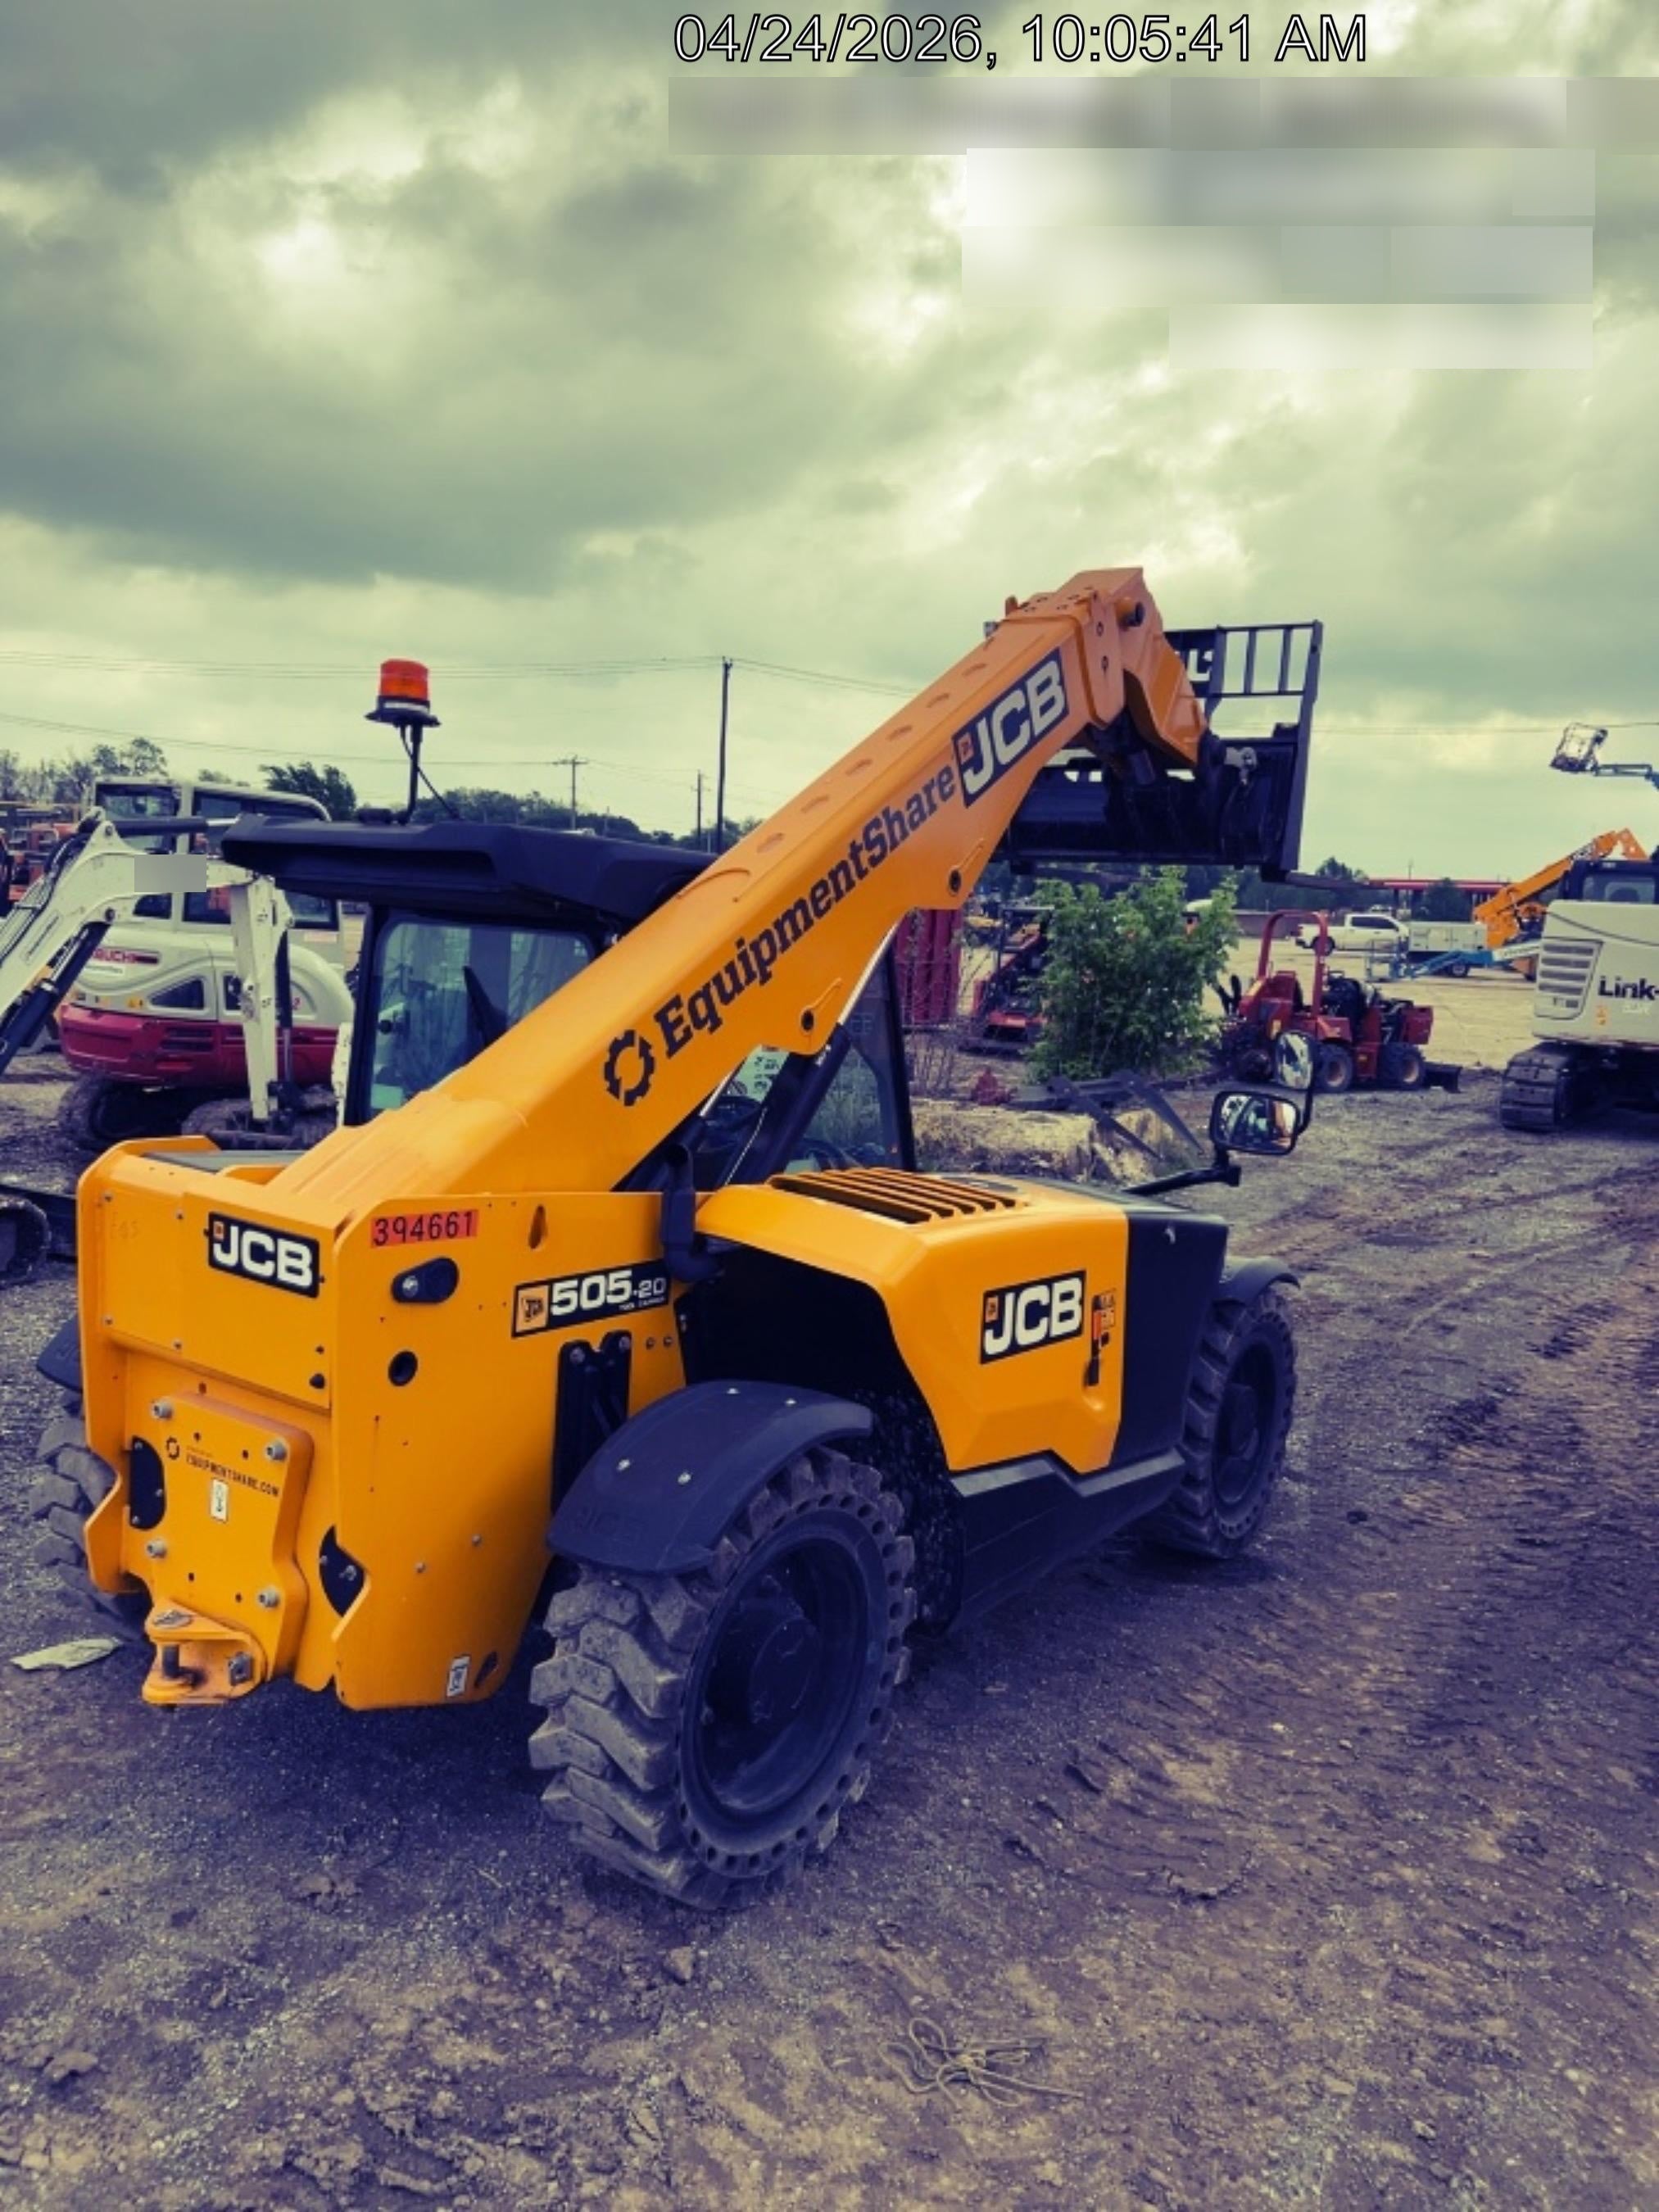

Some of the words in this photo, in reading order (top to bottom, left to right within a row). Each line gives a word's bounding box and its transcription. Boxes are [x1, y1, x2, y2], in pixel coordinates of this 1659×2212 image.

[963, 660, 1065, 795] JCB
[654, 764, 955, 1060] EquipmentShare
[212, 1225, 313, 1289] JCB
[373, 1210, 473, 1247] 394661
[983, 1277, 1083, 1355] JCB
